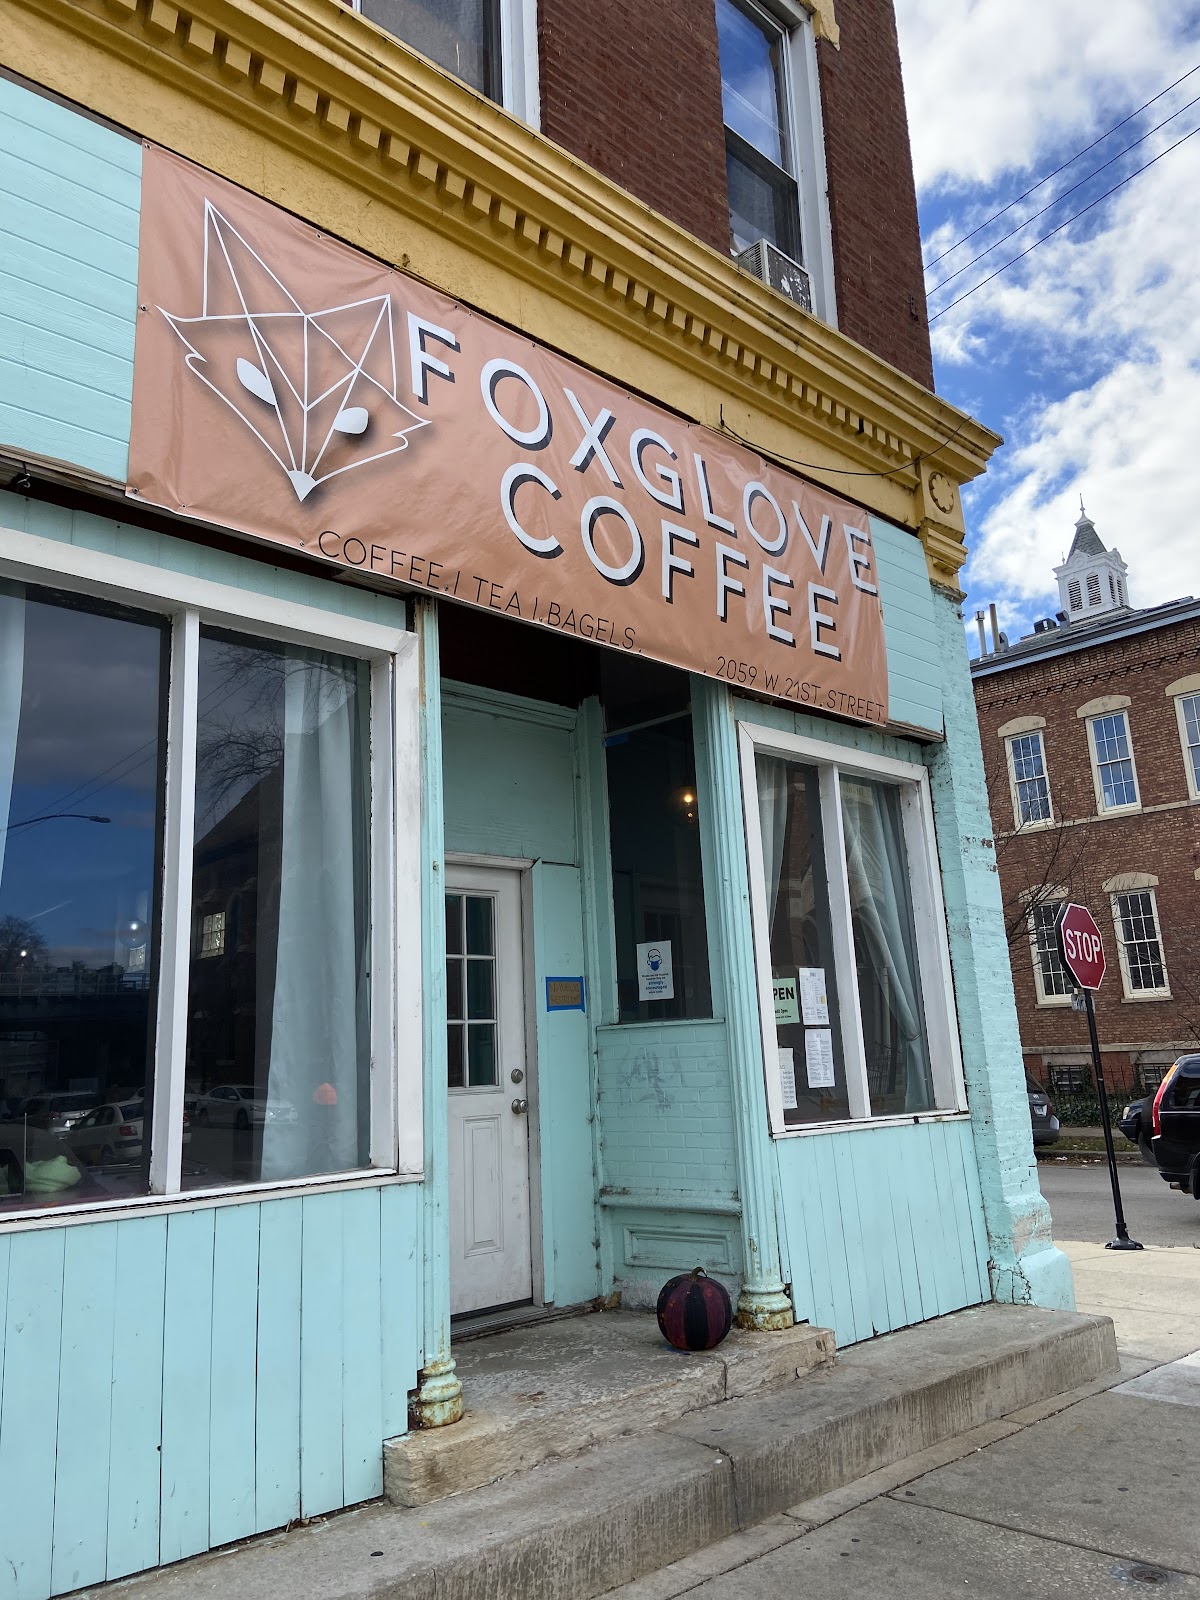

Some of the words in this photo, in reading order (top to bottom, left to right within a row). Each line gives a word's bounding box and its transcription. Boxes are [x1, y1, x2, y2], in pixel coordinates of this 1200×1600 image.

[406, 311, 878, 597] FOXGLOVE
[318, 530, 444, 590] COFFEE
[472, 575, 522, 616] TEA
[547, 601, 636, 650] BAGELS
[501, 462, 842, 662] COFFEE
[715, 656, 758, 686] 2059
[826, 689, 885, 722] STREET
[1065, 929, 1101, 964] STOP
[772, 986, 795, 1001] PEN
